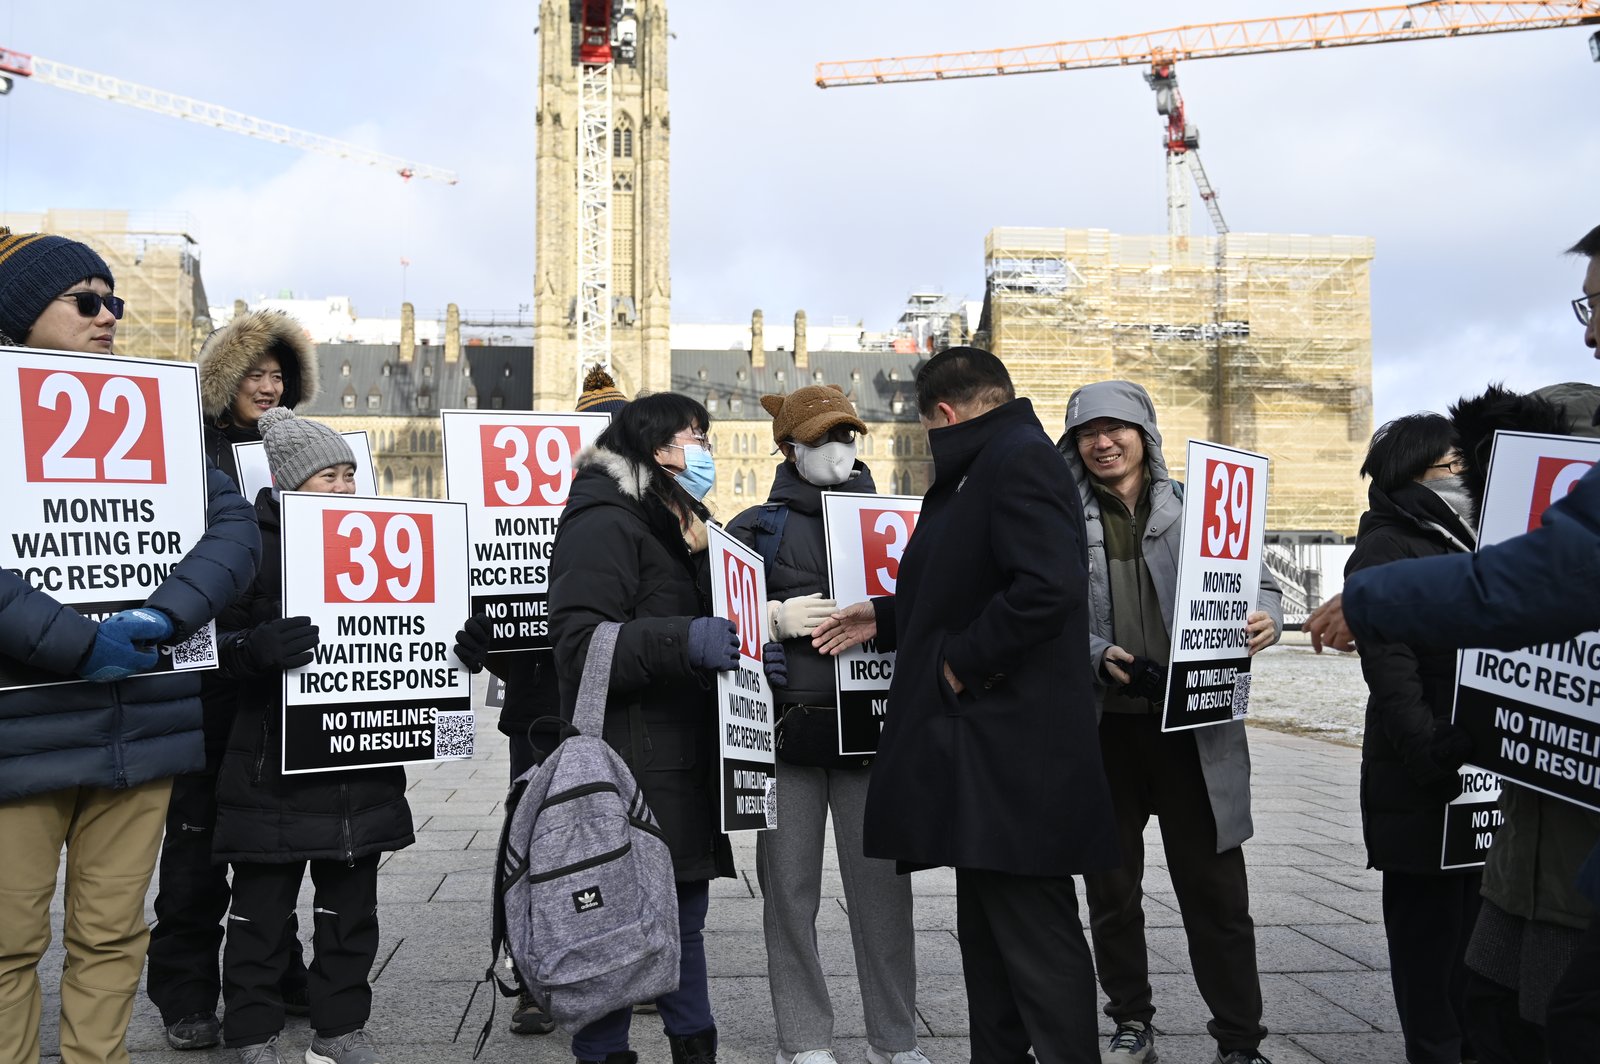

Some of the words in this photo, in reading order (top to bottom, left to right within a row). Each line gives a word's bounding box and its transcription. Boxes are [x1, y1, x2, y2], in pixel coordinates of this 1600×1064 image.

[38, 372, 152, 480] 22
[492, 426, 573, 506] 39
[43, 499, 155, 523] MONTHS
[1207, 462, 1248, 558] 39
[12, 532, 130, 558] WAITING
[138, 531, 182, 555] FOR
[475, 542, 553, 561] WAITING
[874, 511, 918, 594] 3
[336, 512, 423, 601] 39
[510, 566, 549, 585] RES
[1202, 571, 1242, 593] MONTHS
[485, 603, 508, 618] NO
[510, 601, 549, 617] TIME
[728, 556, 757, 657] 90
[1190, 600, 1229, 621] WAITING
[1230, 600, 1248, 621] FOR
[337, 615, 425, 636] MONTHS
[493, 622, 515, 638] NO
[519, 621, 549, 637] RES
[1180, 628, 1203, 650] IRCC
[1204, 627, 1249, 650] RESPONSE
[314, 642, 402, 665] WAITING
[409, 641, 447, 662] FOR
[300, 671, 348, 693] IRCC
[352, 667, 459, 690] RESPONSE
[735, 667, 760, 693] MONTHS
[850, 660, 892, 680] IRCC
[1186, 670, 1200, 689] NO
[1200, 667, 1238, 688] TIMELINES
[1475, 651, 1531, 688] IRCC
[1534, 666, 1600, 707] RESP
[729, 692, 755, 720] WAITING
[756, 700, 768, 723] FOR
[1186, 693, 1199, 712] NO
[1200, 689, 1232, 710] RESULTS
[322, 712, 347, 730] NO
[351, 707, 438, 728] TIMELINES
[1494, 706, 1524, 734] NO
[330, 735, 354, 753] NO
[360, 730, 432, 751] RESULTS
[726, 722, 741, 747] IRCC
[741, 726, 772, 752] RESPONSE
[1500, 737, 1530, 765] NO
[734, 769, 742, 789] NO
[737, 795, 744, 814] NO
[1472, 810, 1489, 828] NO
[1475, 832, 1492, 850] NO
